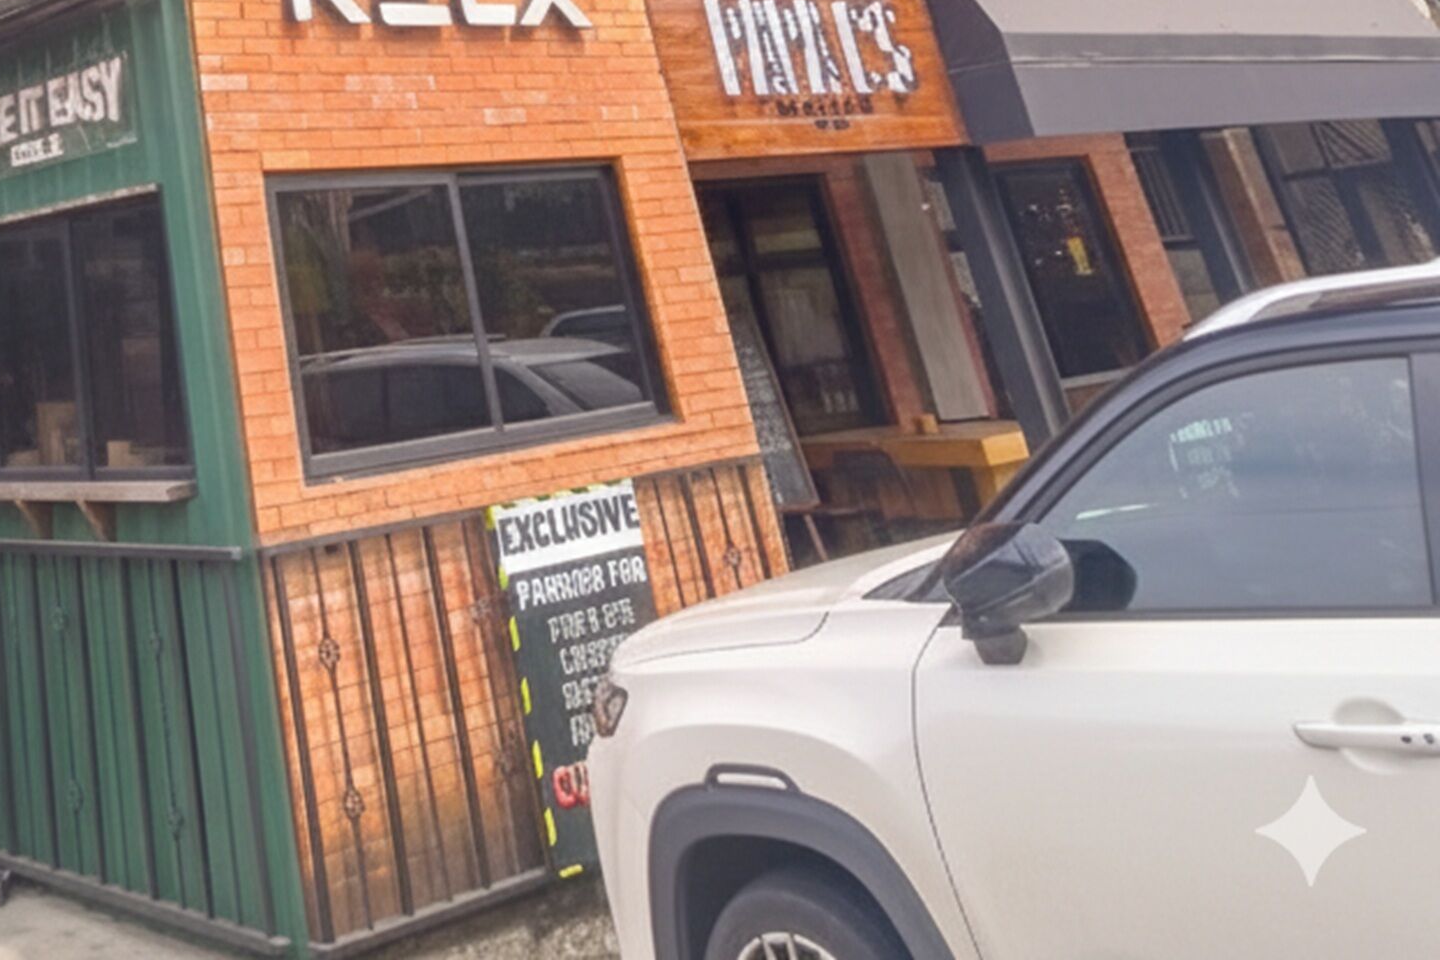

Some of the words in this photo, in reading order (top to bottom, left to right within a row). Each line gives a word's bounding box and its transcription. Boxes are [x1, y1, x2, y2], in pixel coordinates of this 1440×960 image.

[18, 85, 44, 135] IT
[47, 56, 122, 127] EASY
[498, 493, 641, 558] EXCLUSIVE
